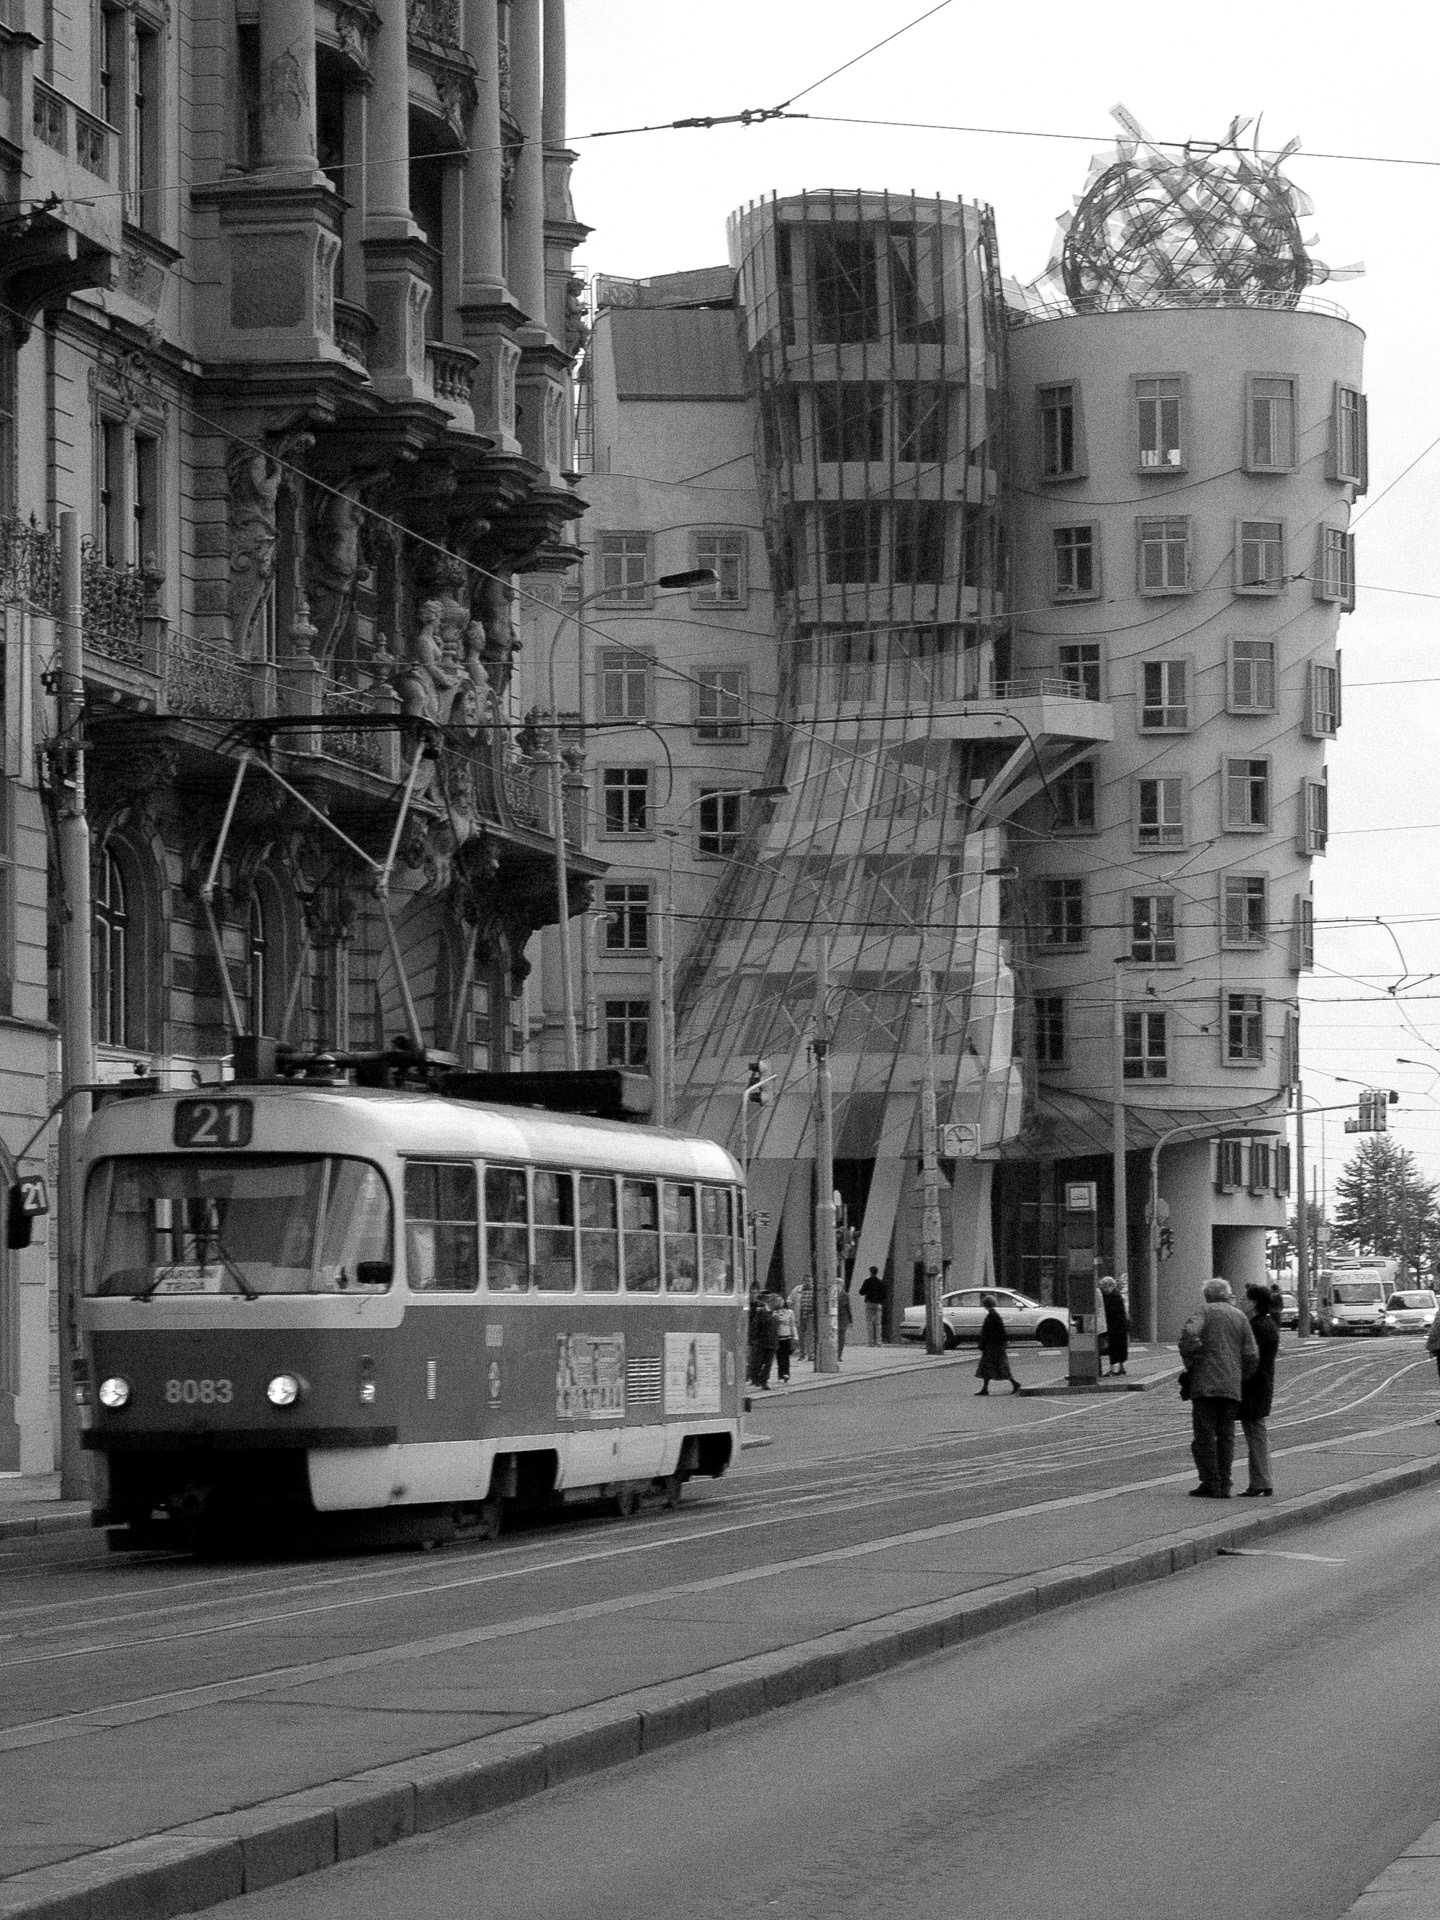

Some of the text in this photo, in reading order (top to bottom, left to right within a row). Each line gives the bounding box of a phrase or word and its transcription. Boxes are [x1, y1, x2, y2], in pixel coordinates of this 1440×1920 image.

[190, 1103, 240, 1142] 21
[21, 1181, 47, 1210] 21
[166, 1379, 234, 1403] 8083
